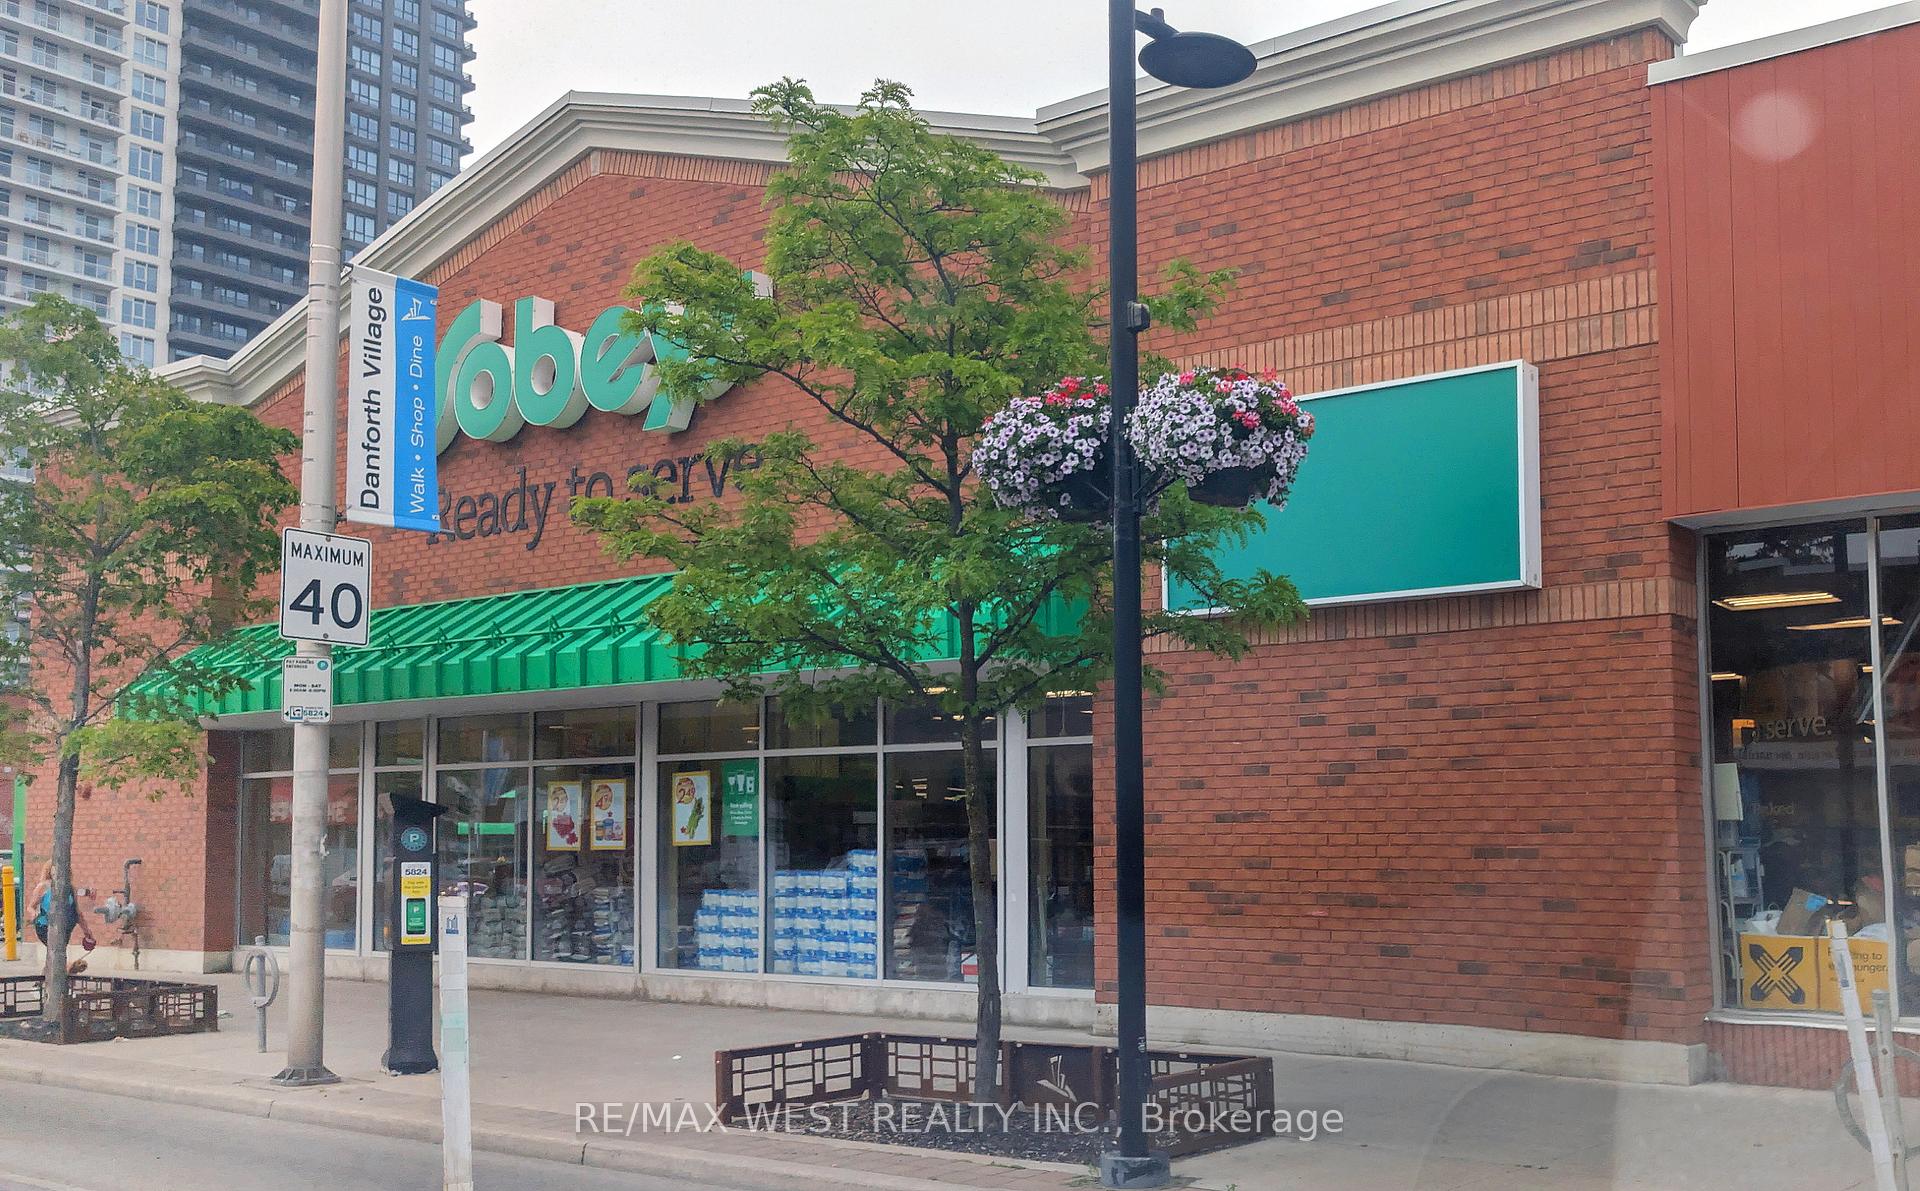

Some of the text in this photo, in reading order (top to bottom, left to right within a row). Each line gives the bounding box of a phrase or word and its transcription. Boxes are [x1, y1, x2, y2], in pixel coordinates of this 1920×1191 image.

[360, 287, 388, 510] Danforth Village
[409, 335, 426, 513] Walk Shop Dine
[289, 579, 362, 629] 40
[291, 541, 364, 567] MAXIMUM
